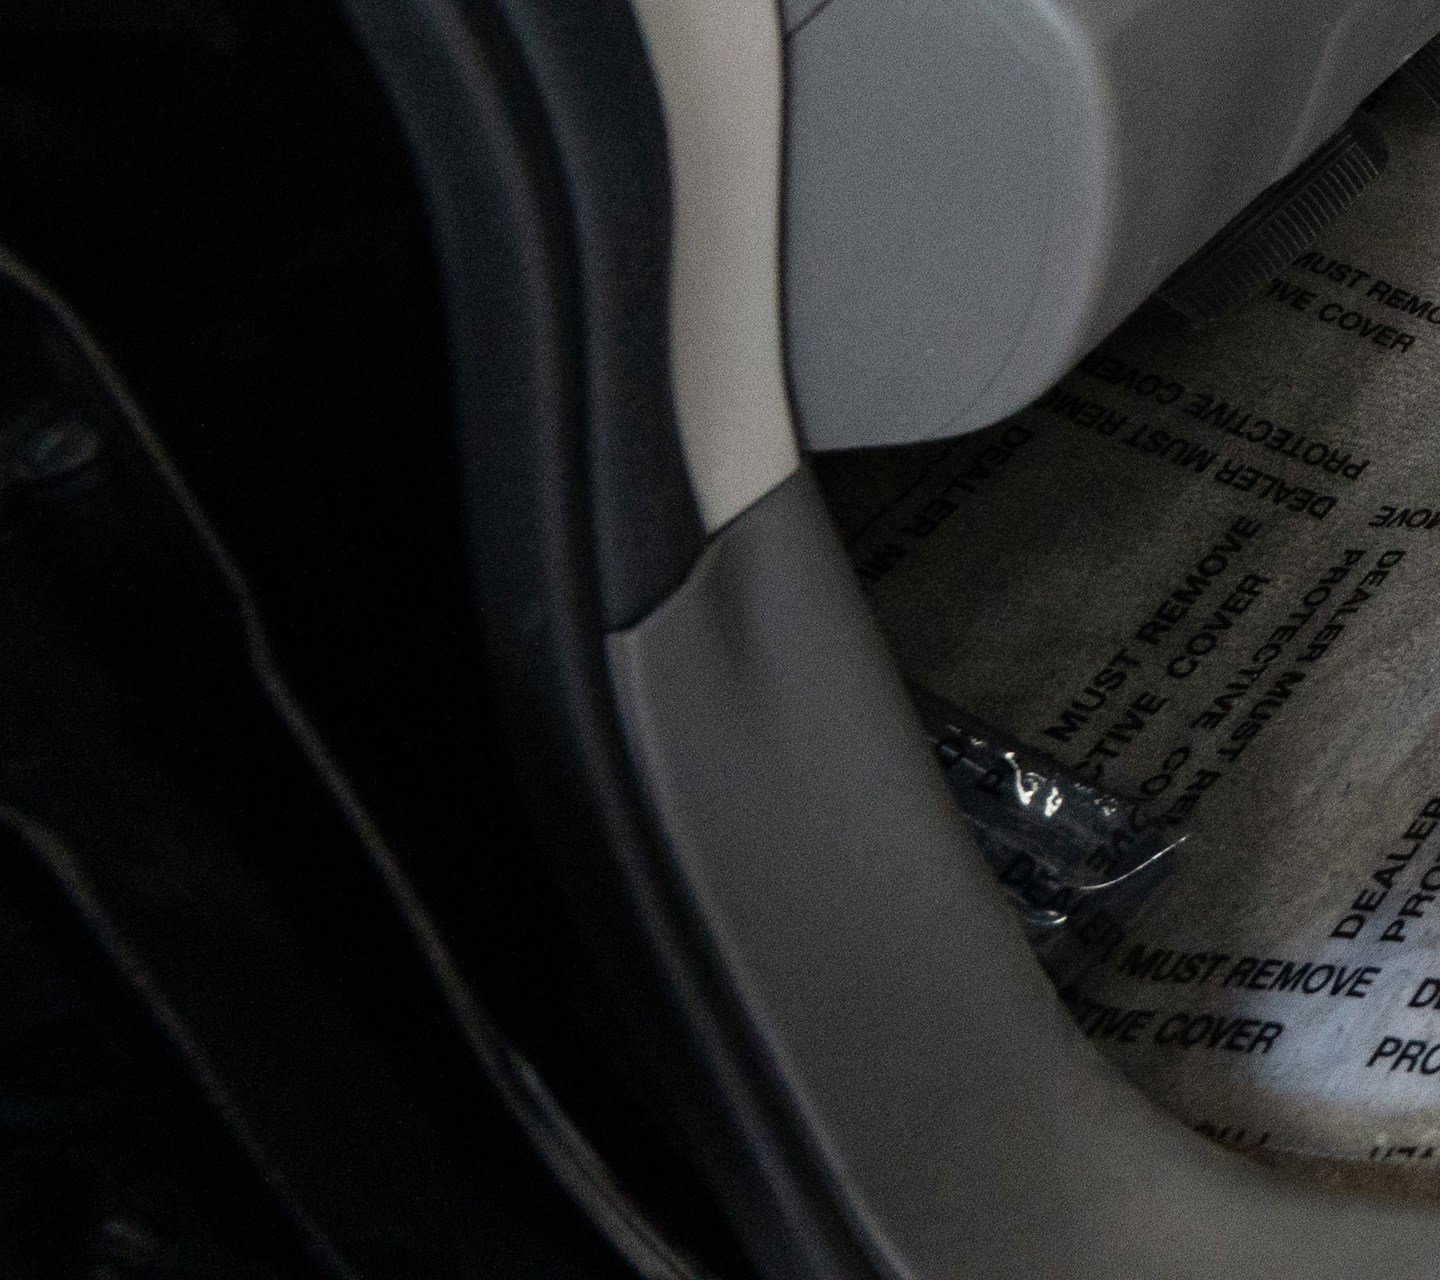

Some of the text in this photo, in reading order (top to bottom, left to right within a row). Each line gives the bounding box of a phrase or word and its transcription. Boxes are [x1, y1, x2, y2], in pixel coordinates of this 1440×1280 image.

[1318, 302, 1417, 355] COVER
[1037, 390, 1339, 520] DEALER MUST REM
[1183, 391, 1371, 481] PROTECTIVE
[1043, 646, 1144, 742] MUST
[1135, 515, 1263, 642] REMOVE
[1165, 571, 1273, 681] COVER
[1192, 549, 1366, 731] PROTECTIVE
[1217, 550, 1407, 764] DEALER MUST
[1116, 948, 1223, 983] MUST
[1223, 961, 1382, 1000] REMOVE
[1159, 1011, 1284, 1056] COVER
